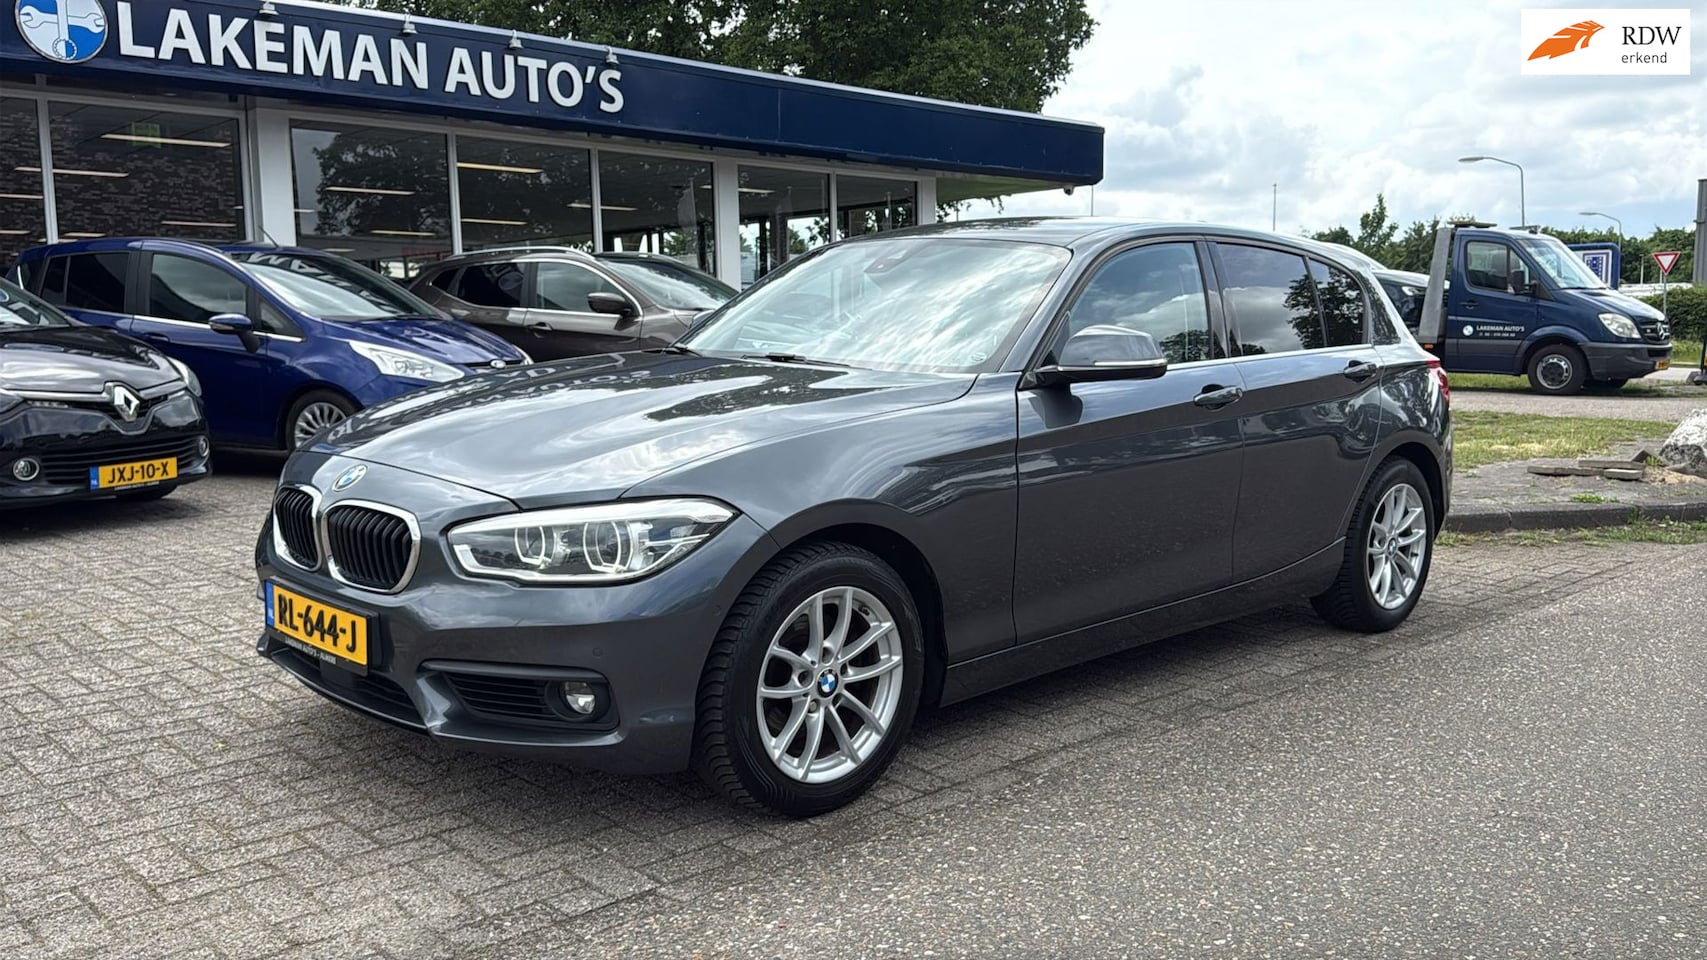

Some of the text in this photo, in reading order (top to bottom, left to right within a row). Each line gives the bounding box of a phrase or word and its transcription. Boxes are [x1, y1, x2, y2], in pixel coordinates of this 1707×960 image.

[117, 1, 624, 113] LAKEMAN AUTO'S
[108, 461, 169, 484] JXJ-10-X
[278, 594, 357, 653] RL-644-J
